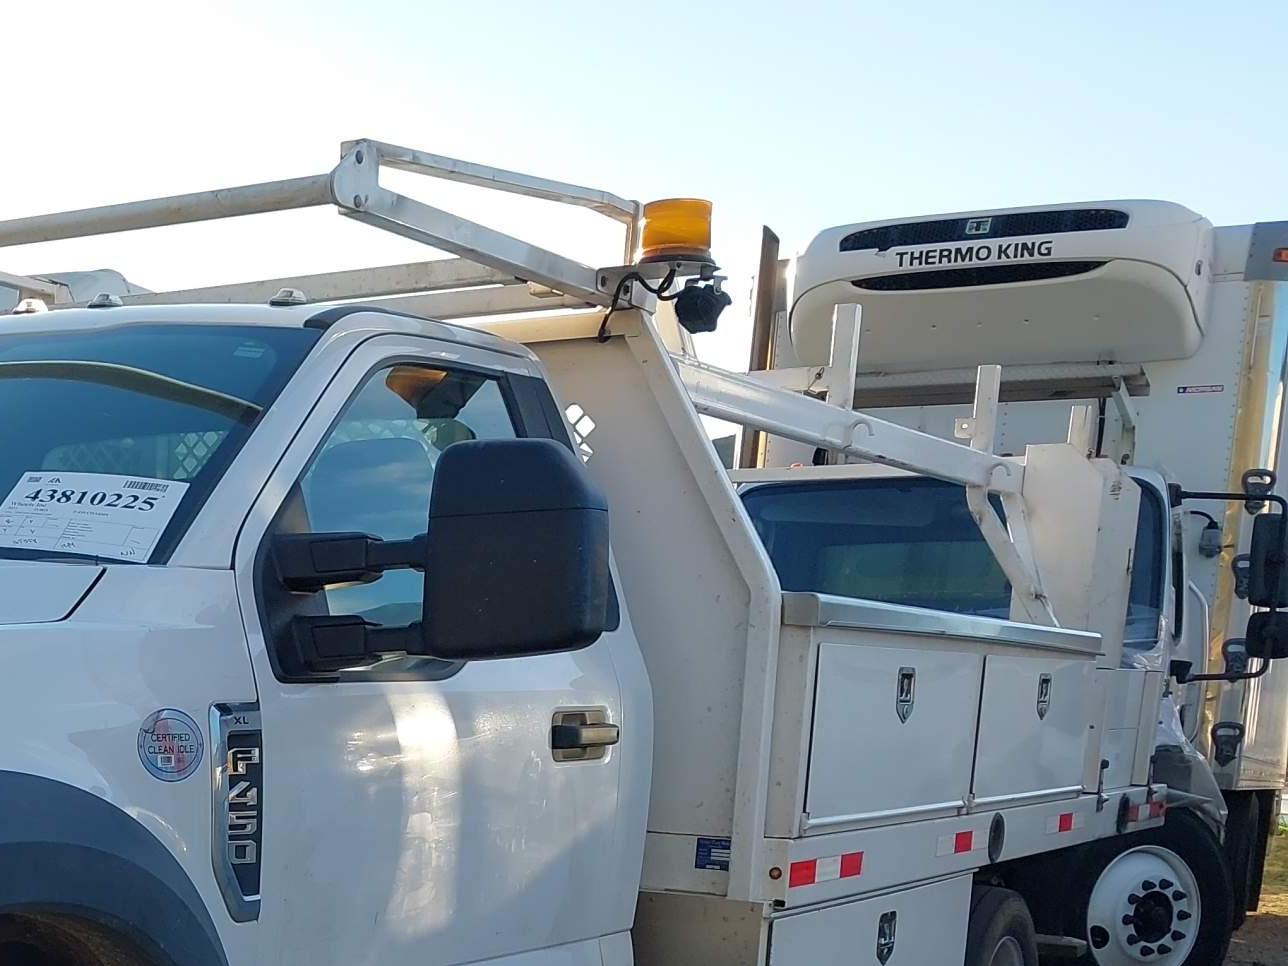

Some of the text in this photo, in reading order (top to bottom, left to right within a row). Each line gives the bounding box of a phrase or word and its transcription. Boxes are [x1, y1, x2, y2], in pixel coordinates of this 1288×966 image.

[895, 240, 1053, 268] THERMO KING
[24, 488, 161, 512] 43810225
[234, 716, 249, 725] XL
[150, 732, 191, 743] CERTIFIED
[147, 744, 195, 755] CLEAN IDLE
